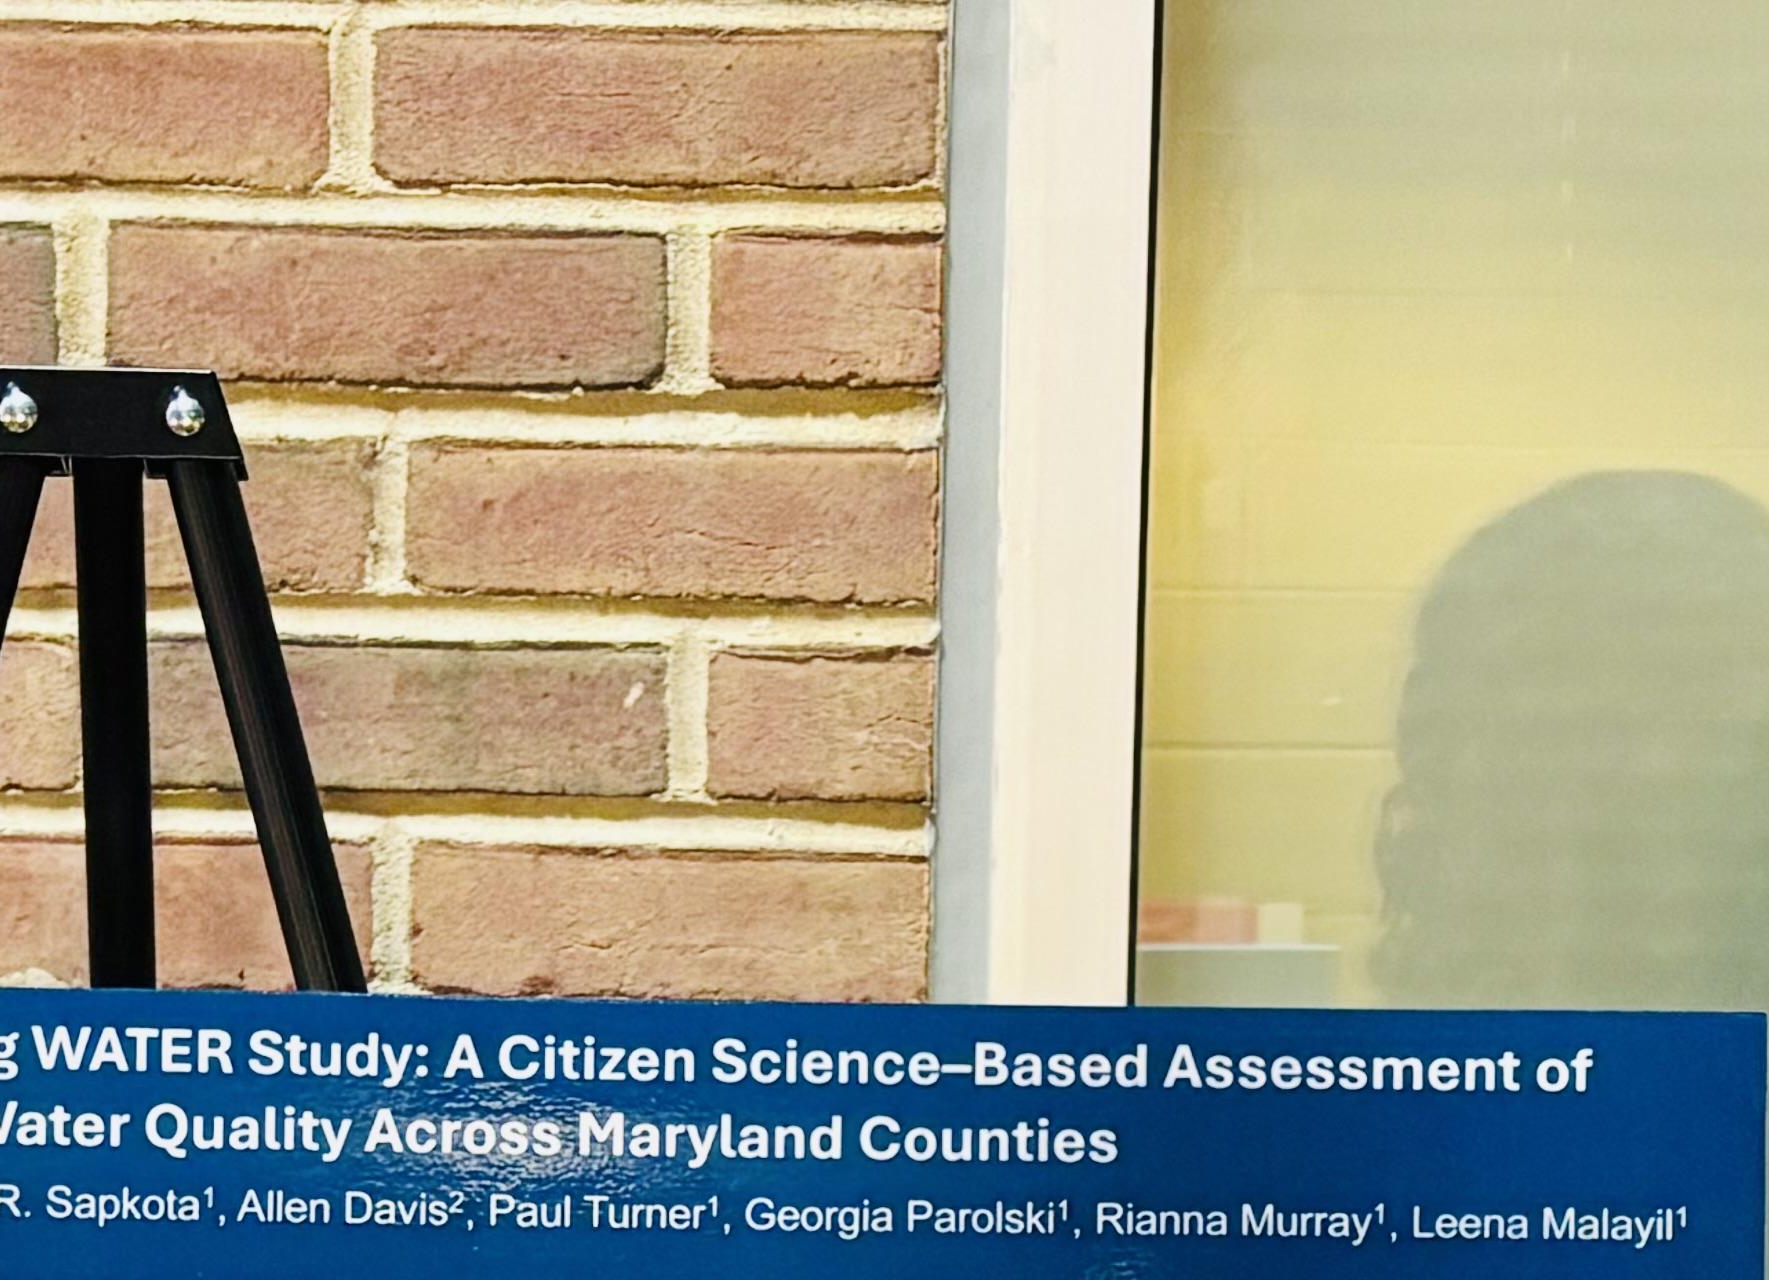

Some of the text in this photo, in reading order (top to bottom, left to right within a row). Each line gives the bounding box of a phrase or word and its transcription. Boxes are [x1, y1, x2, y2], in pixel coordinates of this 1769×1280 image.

[30, 1024, 234, 1074] WATER
[248, 1029, 429, 1088] Study:
[443, 1034, 485, 1080] A
[498, 1036, 696, 1084] Citizen
[1162, 1044, 1521, 1092] Assessment
[1536, 1048, 1594, 1093] of
[145, 1103, 353, 1163] Quality
[364, 1107, 563, 1157] Across
[579, 1111, 844, 1170] Maryland
[859, 1115, 1120, 1165] Counties
[236, 1189, 331, 1224] Allen
[489, 1192, 573, 1228] Paul
[744, 1196, 894, 1241] Georgia
[1096, 1201, 1228, 1236] Rianna
[1413, 1205, 1529, 1240] Leena
